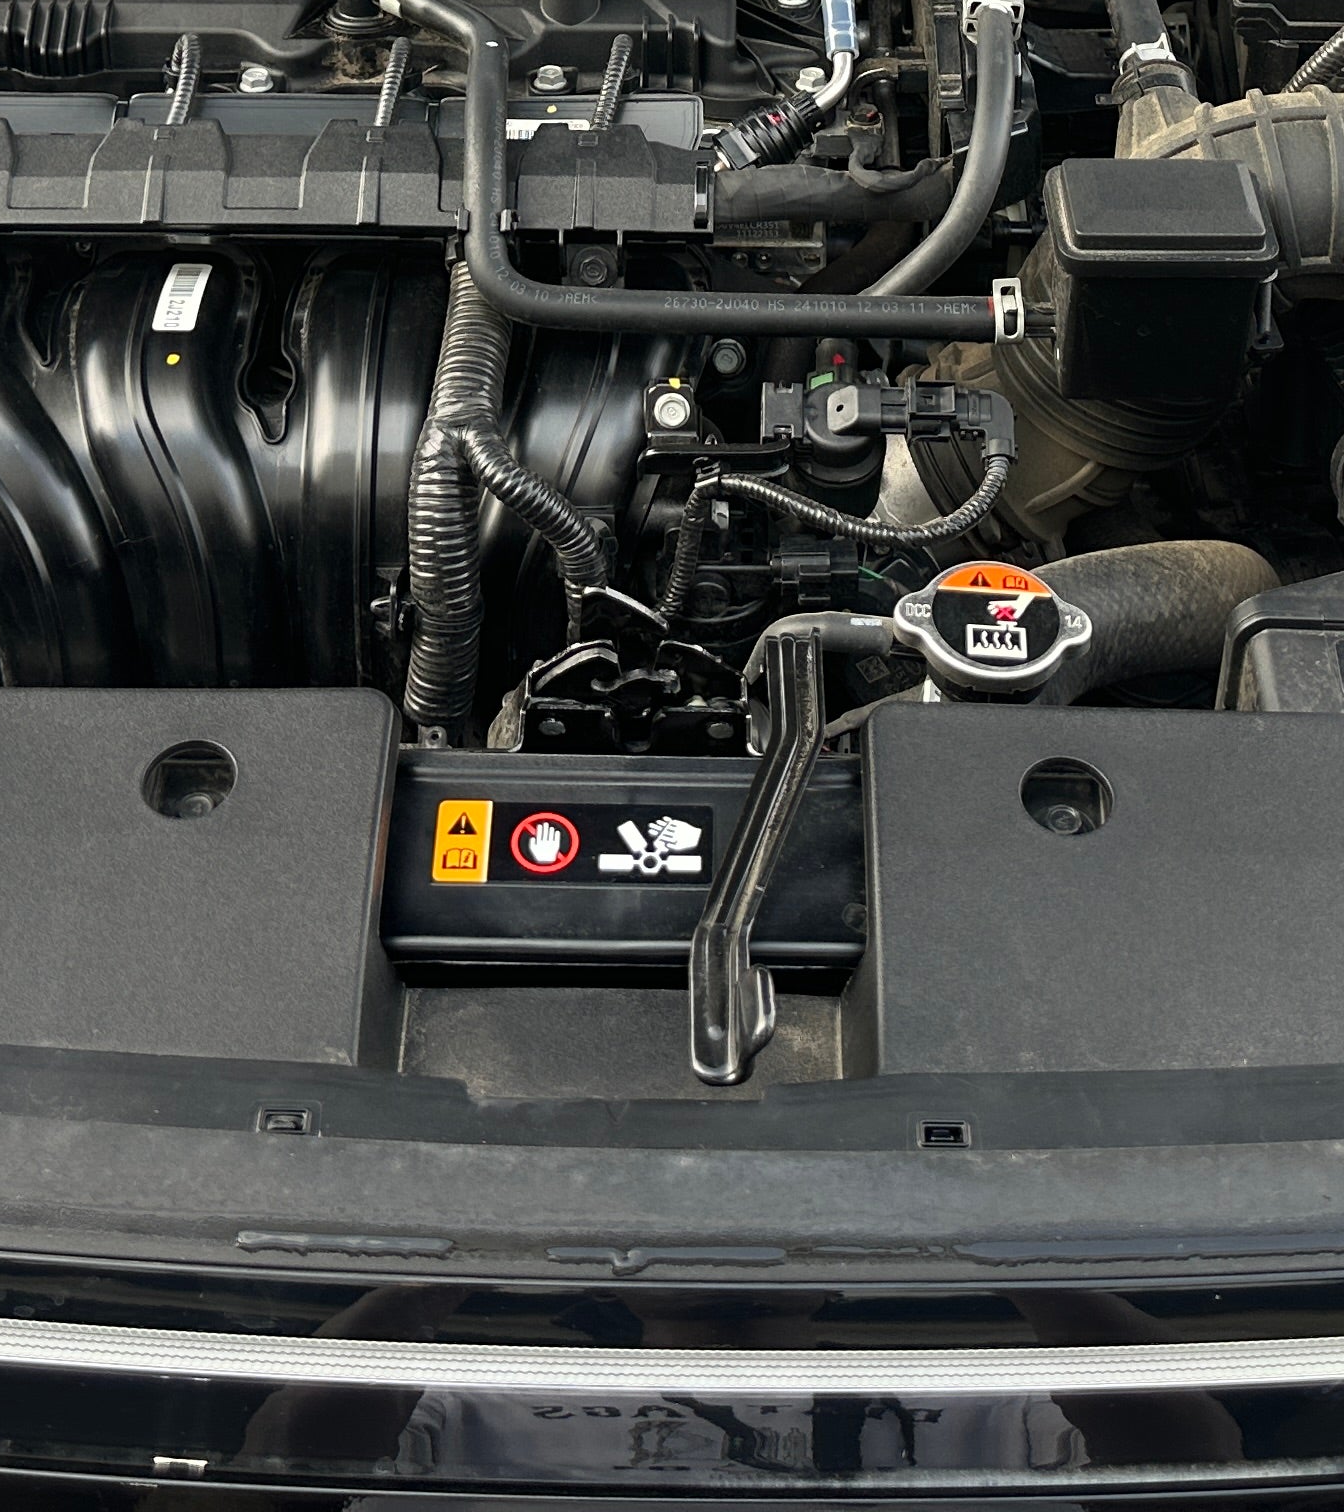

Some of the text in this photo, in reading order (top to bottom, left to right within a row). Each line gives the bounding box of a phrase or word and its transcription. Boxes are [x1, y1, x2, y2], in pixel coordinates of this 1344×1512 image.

[164, 299, 186, 328] 2J210
[664, 296, 760, 311] 26730-2J040
[767, 300, 785, 312] HS
[793, 300, 847, 314] 241010
[905, 602, 932, 618] DCC
